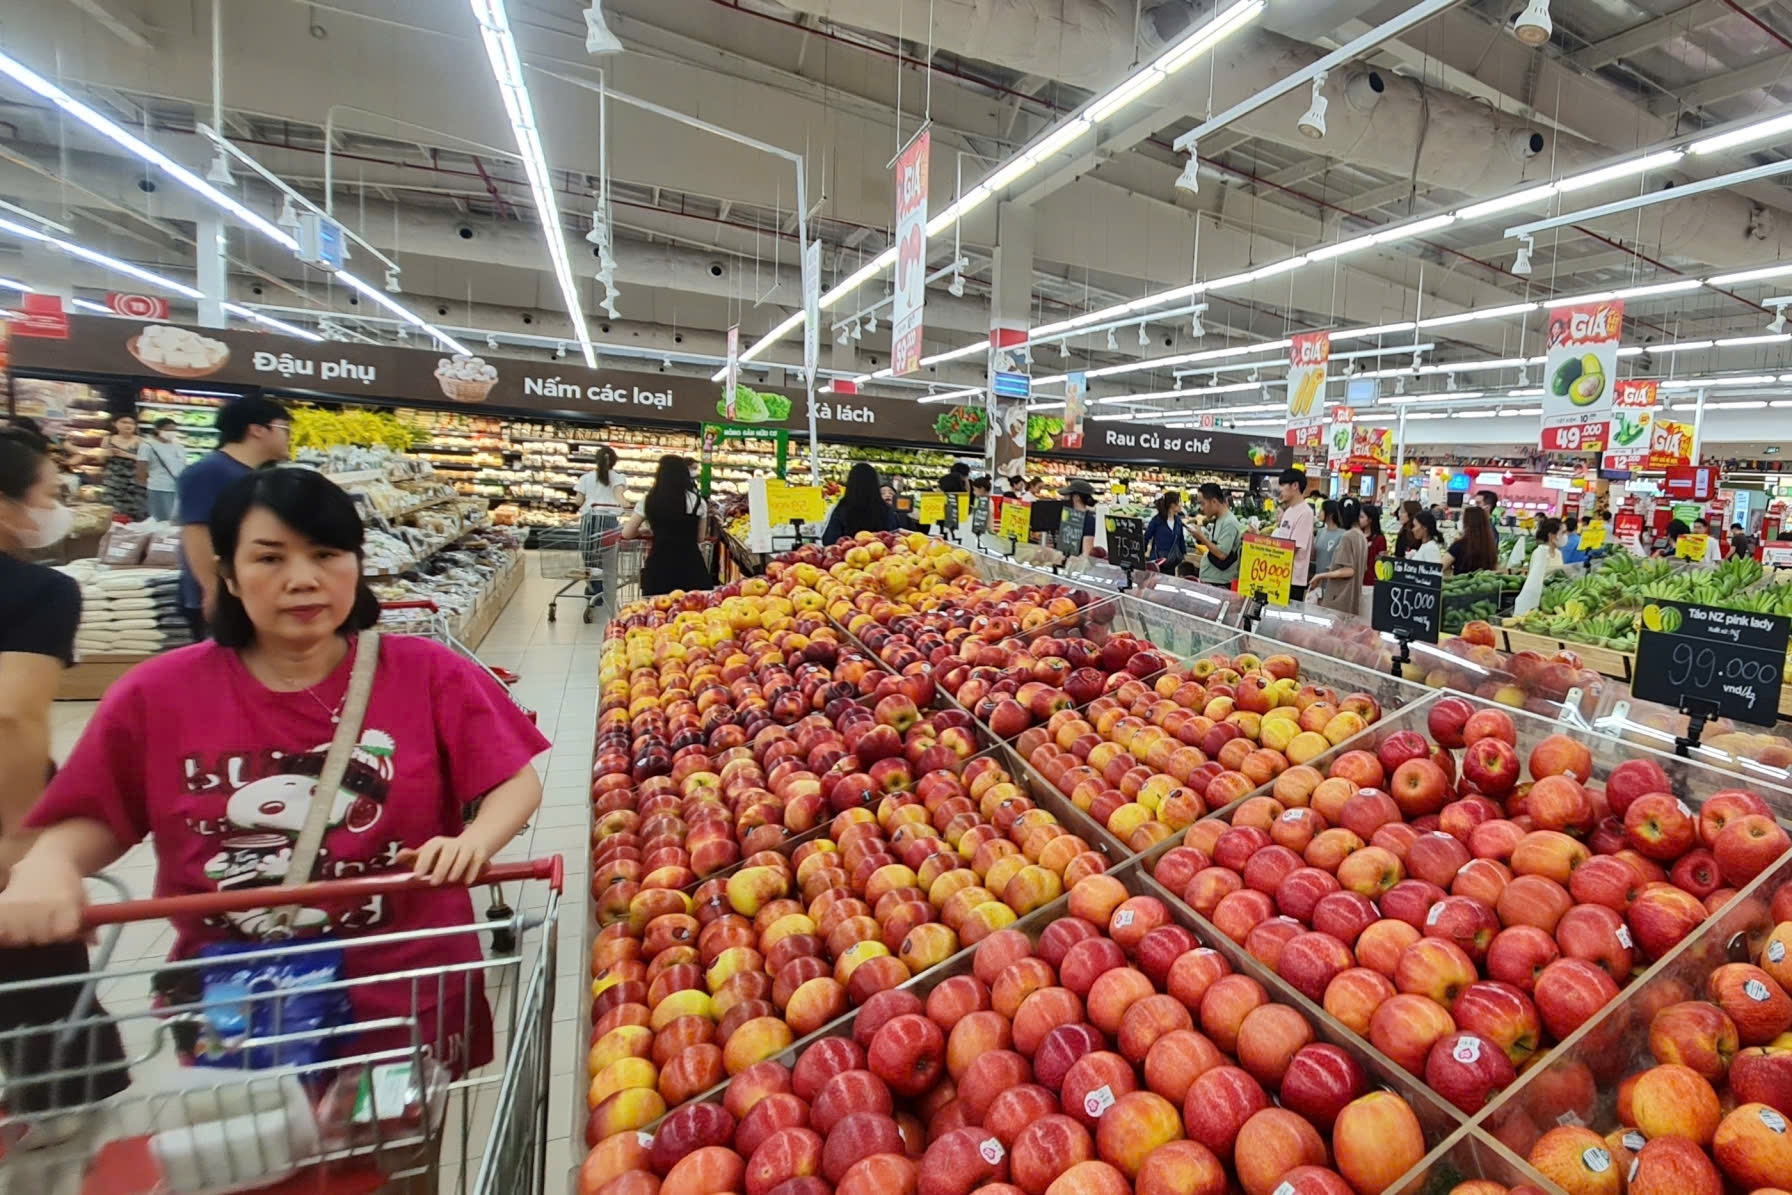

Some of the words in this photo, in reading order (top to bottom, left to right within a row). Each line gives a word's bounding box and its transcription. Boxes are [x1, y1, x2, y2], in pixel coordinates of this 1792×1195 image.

[1570, 307, 1611, 339] GIÁ
[252, 351, 314, 378] Đậu
[320, 359, 376, 384] phụ
[524, 376, 581, 399] Nấm
[587, 384, 627, 402] các
[633, 386, 673, 410] loại
[836, 404, 875, 423] lách
[1106, 430, 1135, 446] Rau
[1140, 432, 1160, 449] Củ
[1164, 438, 1181, 450] sơ
[1185, 437, 1212, 453] chế
[1390, 587, 1435, 619] 85.000
[1688, 608, 1707, 620] Táo
[1708, 611, 1725, 623] NZ
[1725, 614, 1749, 627] pink
[1750, 617, 1774, 632] lady
[1668, 643, 1777, 688] 99.000
